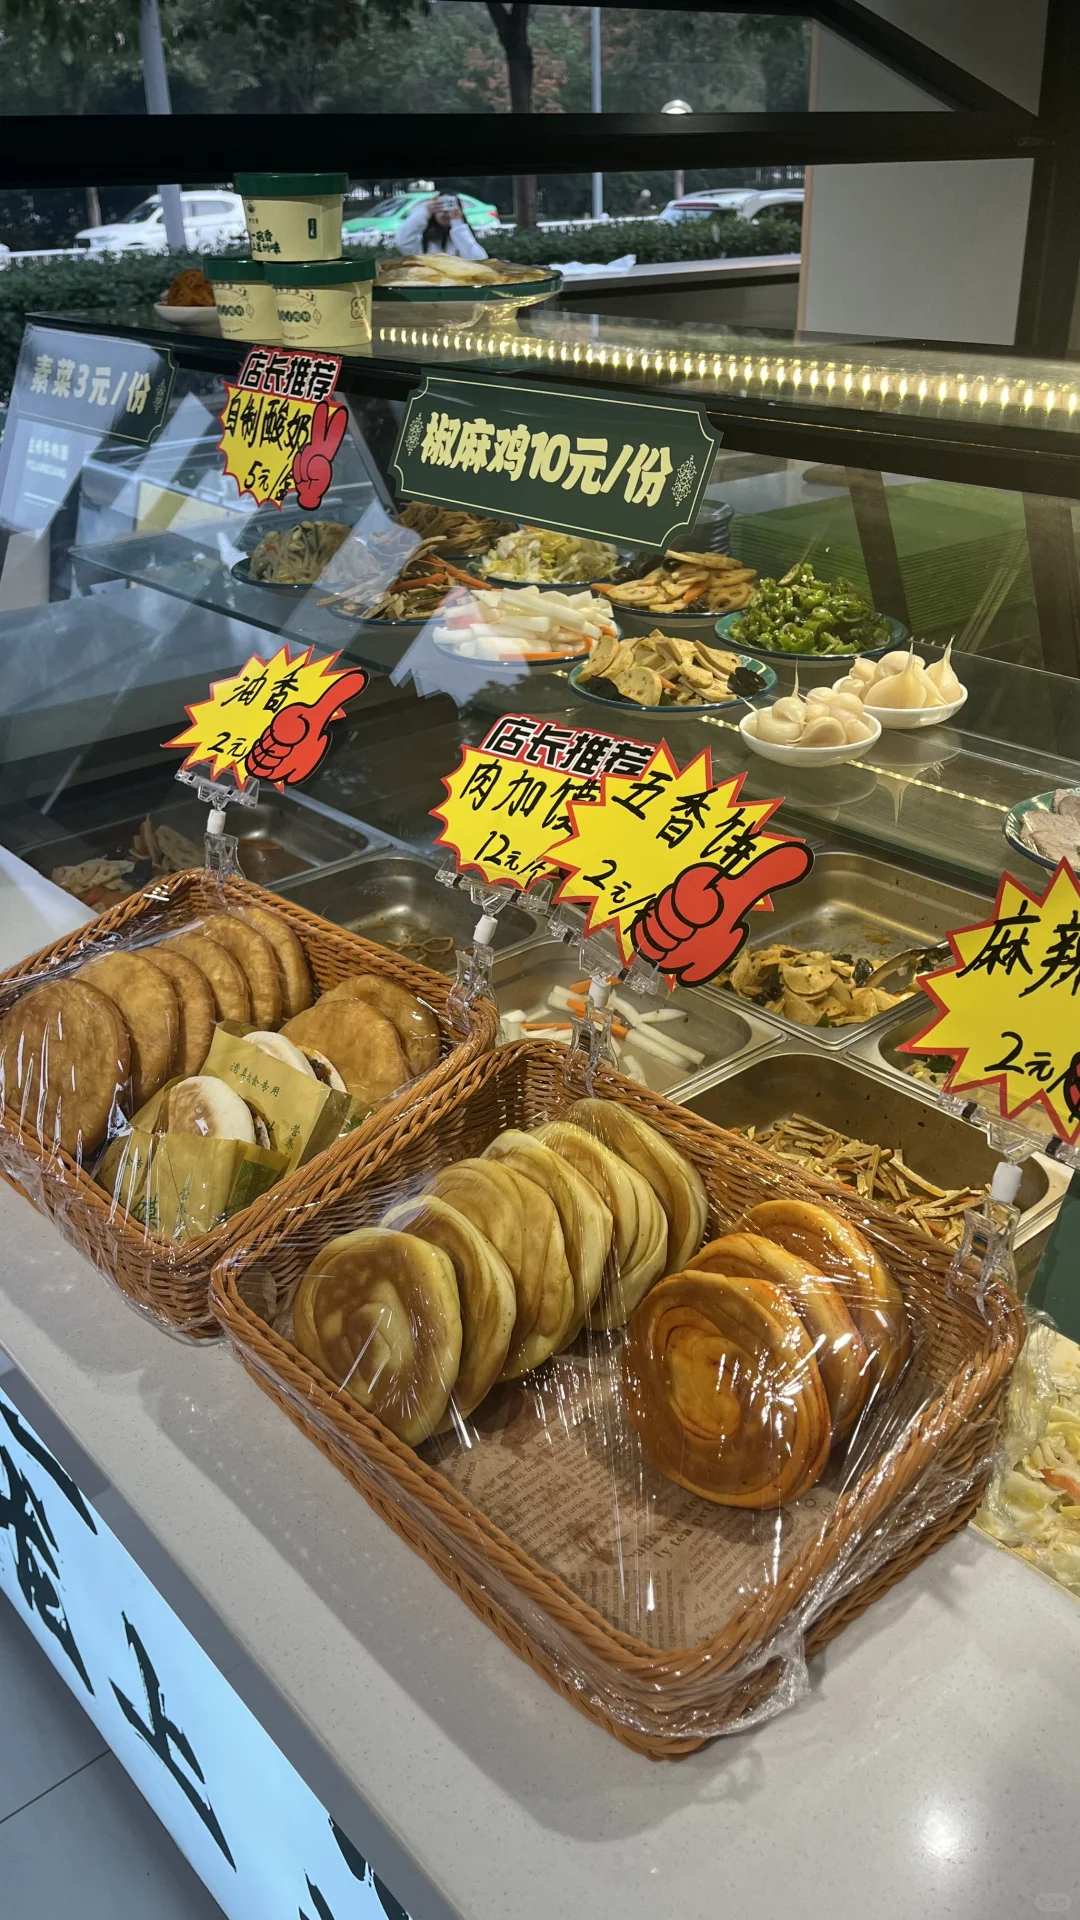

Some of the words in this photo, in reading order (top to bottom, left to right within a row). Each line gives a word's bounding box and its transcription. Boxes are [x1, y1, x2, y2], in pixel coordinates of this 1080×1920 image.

[30, 354, 151, 415] 素菜3元/份
[239, 351, 337, 401] 店长推荐
[225, 389, 312, 460] 自制酸奶
[420, 411, 673, 507] 椒麻鸡10元/份
[221, 664, 305, 713] 油香
[485, 717, 655, 776] 店长推荐
[474, 831, 548, 886] 12元/个
[611, 769, 763, 890] 五香饼
